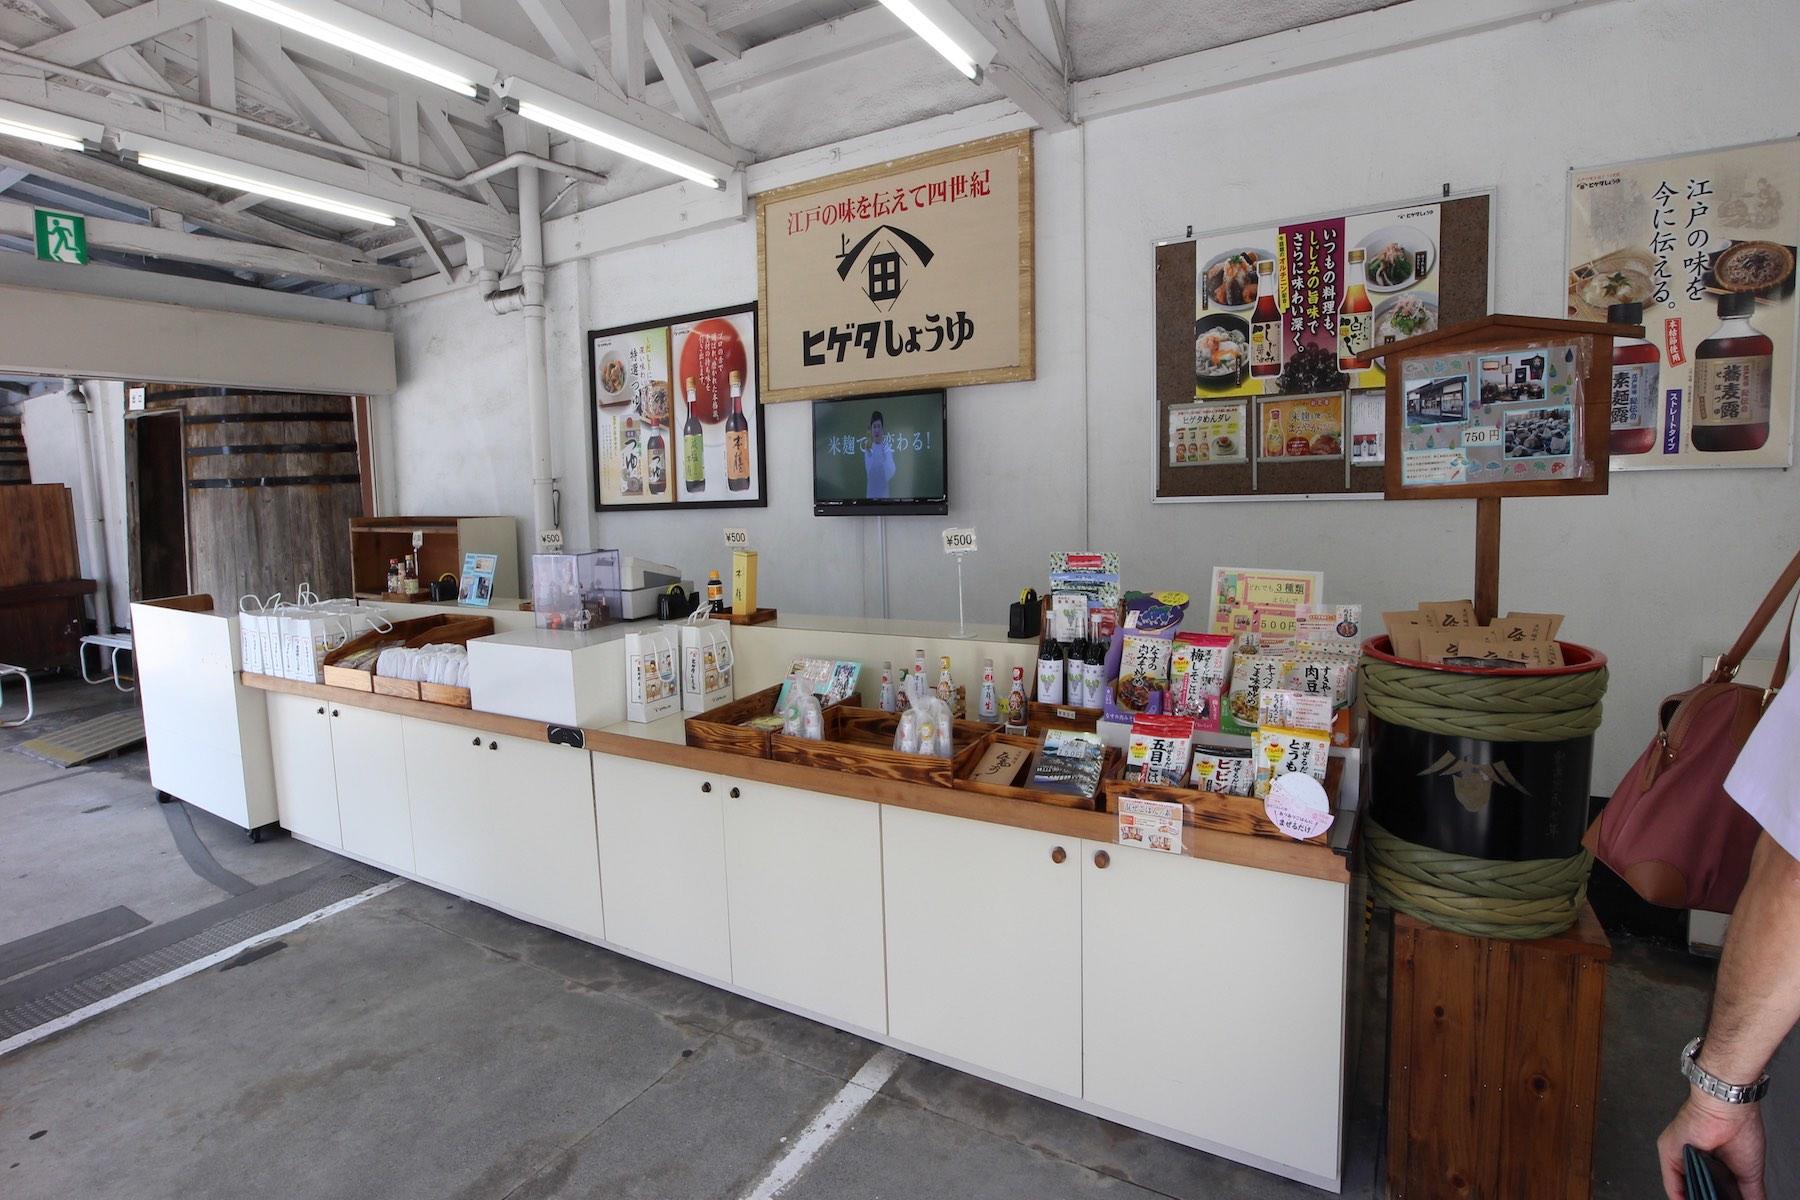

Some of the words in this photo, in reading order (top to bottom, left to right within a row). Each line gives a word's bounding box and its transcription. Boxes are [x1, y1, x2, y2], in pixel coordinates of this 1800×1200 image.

[788, 169, 990, 235] 江戸の味を伝えて四世紀
[1649, 181, 1678, 310] 今に伝える。
[1684, 178, 1714, 302] 江戸の味を
[1290, 232, 1304, 353] さらに味わい深く。
[1306, 230, 1320, 335] しじみの旨味で
[1321, 229, 1337, 337] いつもの料理も、
[803, 311, 975, 367] ヒゲタしょうゆ
[1183, 413, 1231, 425] ヒゲタめんダレ
[1465, 430, 1486, 443] 750
[1489, 429, 1500, 441] 円
[1667, 392, 1679, 452] ストレートタイプ
[946, 534, 972, 547] ¥500
[1148, 644, 1160, 671] なすの
[1187, 648, 1204, 701] 梅しそごはん
[1279, 819, 1311, 834] まぜるだけ
